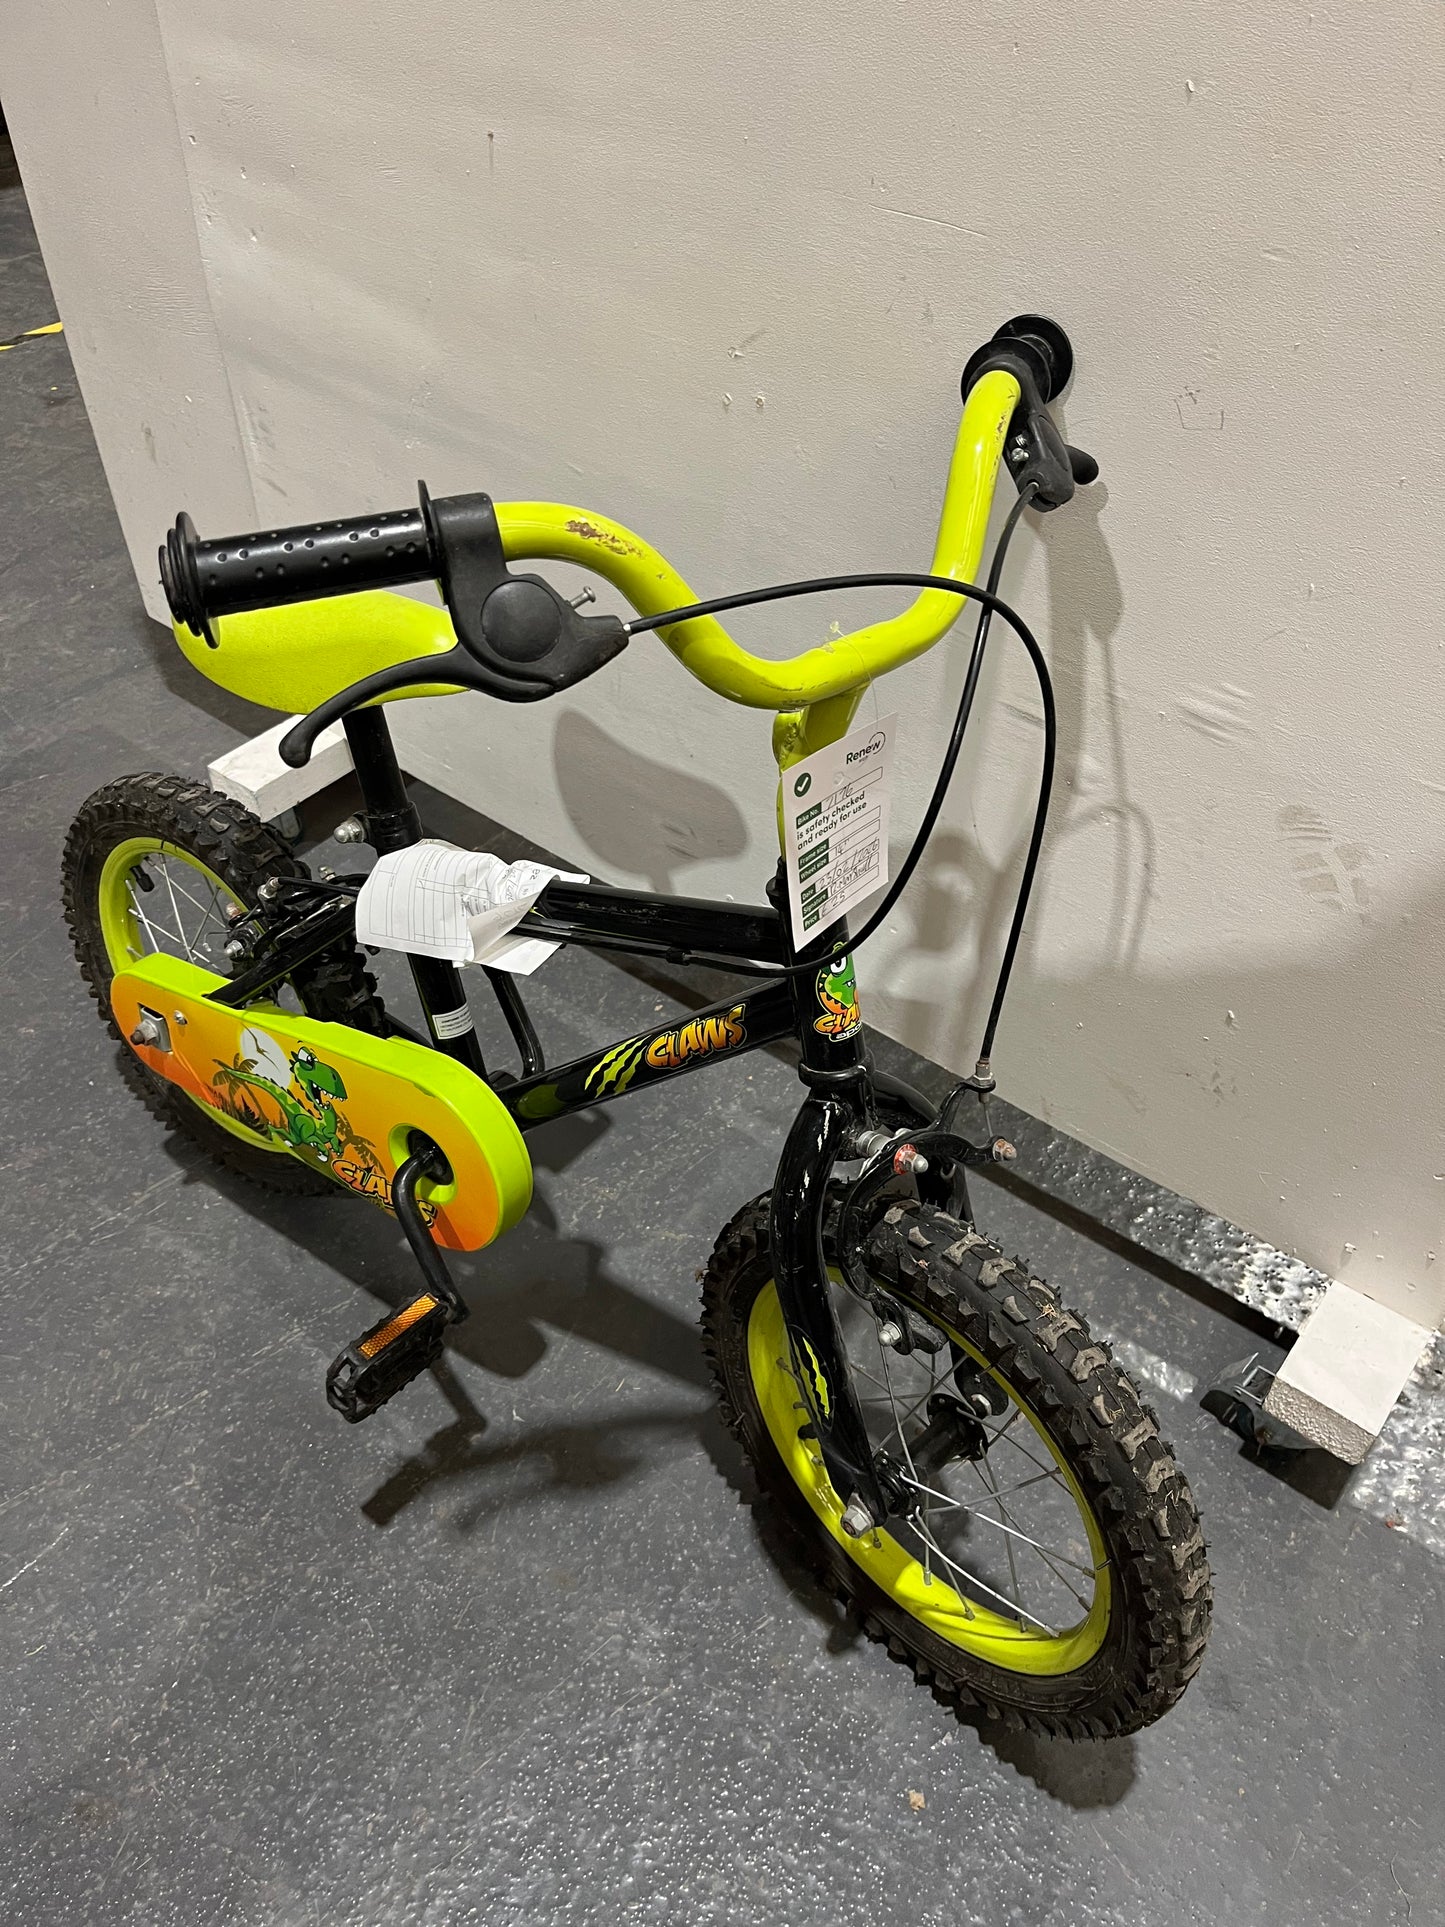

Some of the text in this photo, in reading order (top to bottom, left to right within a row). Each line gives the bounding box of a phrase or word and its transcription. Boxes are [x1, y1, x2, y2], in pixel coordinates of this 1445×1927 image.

[846, 740, 881, 764] Renew
[796, 791, 865, 841] is safety checked
[797, 802, 867, 850] and ready for use
[800, 851, 816, 865] Frame
[800, 865, 817, 879] Wheel
[802, 888, 814, 900] Date
[803, 894, 826, 913] Signature
[804, 914, 817, 928] Price
[645, 1003, 747, 1070] CLAWS
[331, 1159, 437, 1227] CLAS
